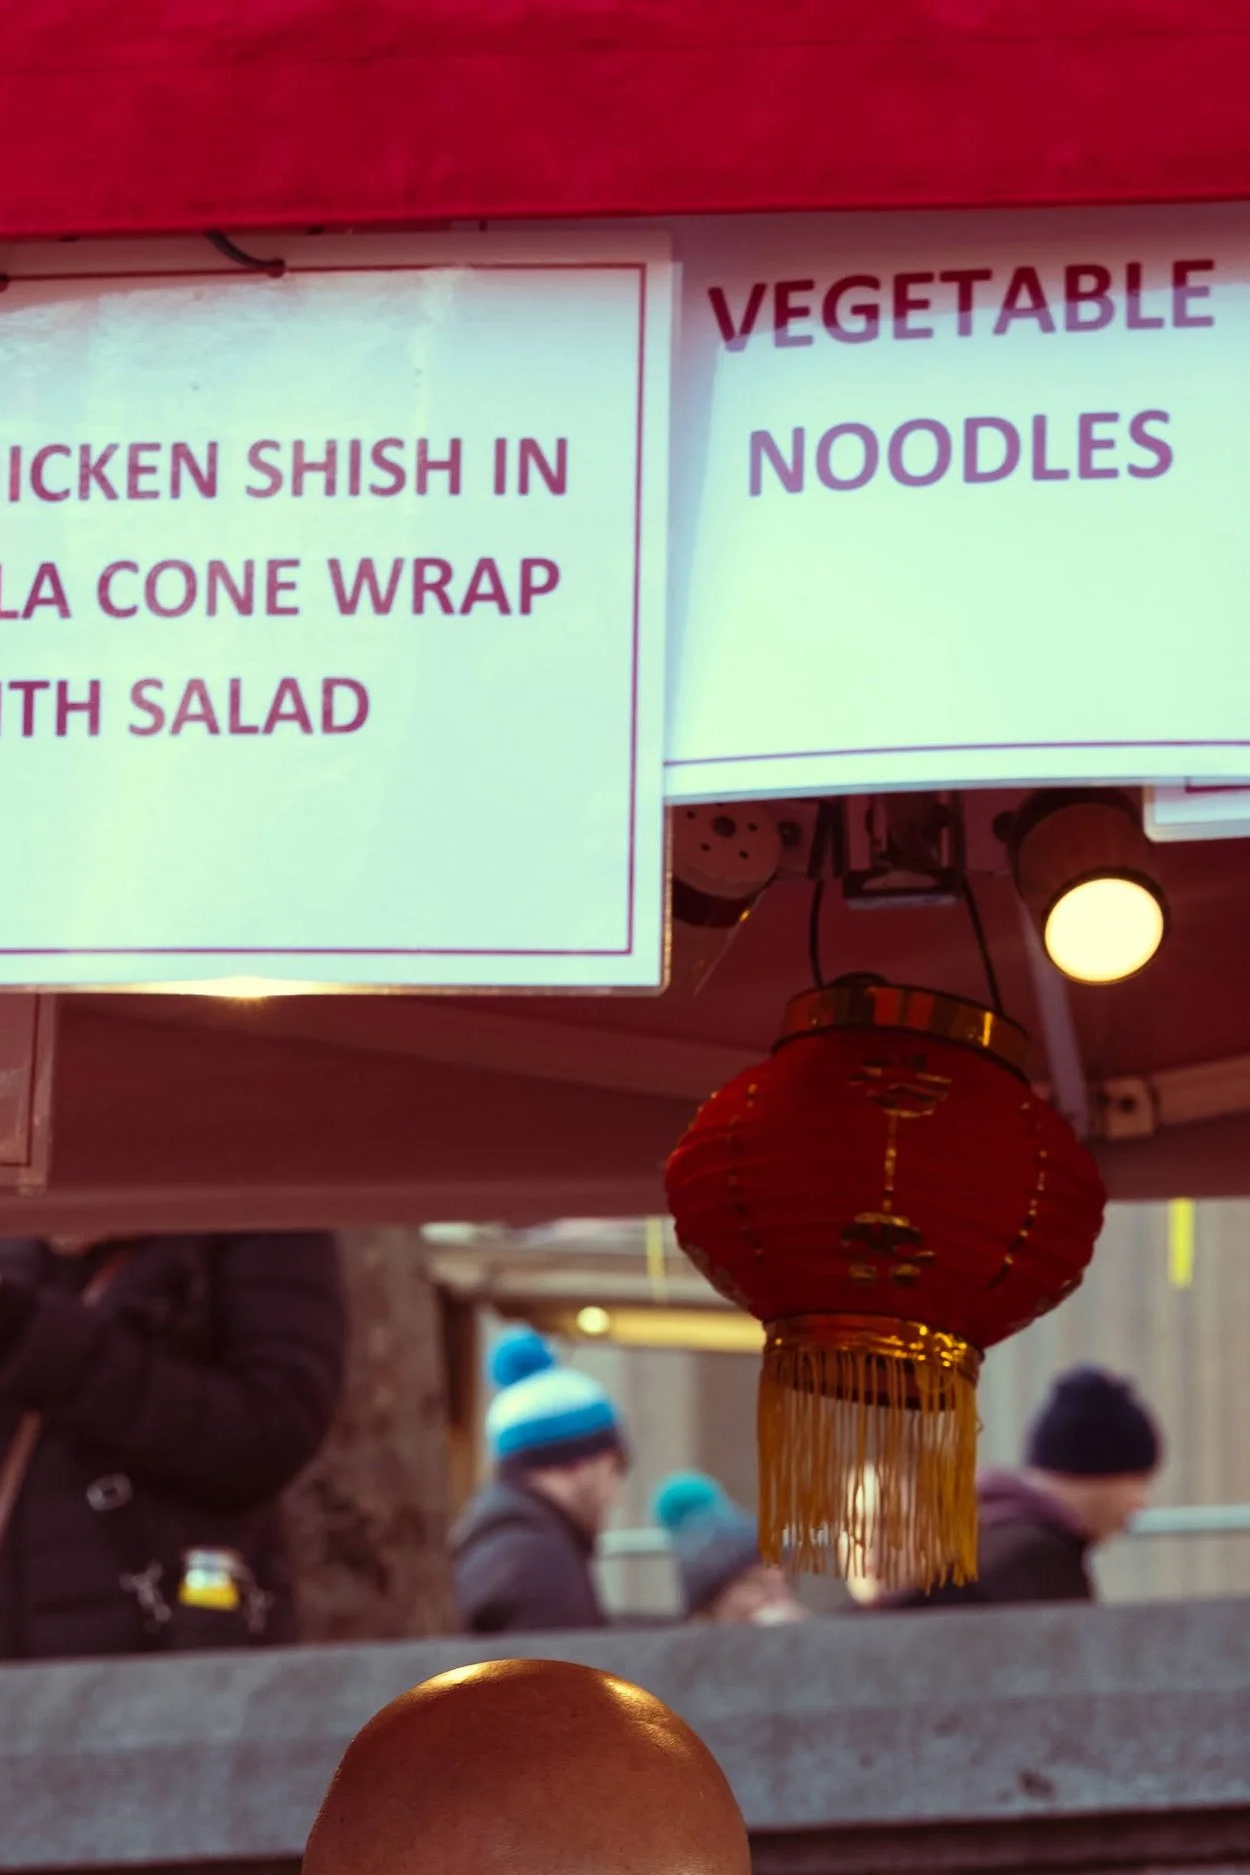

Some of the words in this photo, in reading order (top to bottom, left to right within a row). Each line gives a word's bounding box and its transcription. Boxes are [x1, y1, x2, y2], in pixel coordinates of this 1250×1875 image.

[707, 258, 1216, 353] VEGETABLE
[245, 436, 465, 500] SHISH
[492, 437, 571, 497] IN
[748, 409, 1174, 497] NOODLES
[96, 558, 301, 621] CONE
[326, 556, 561, 617] WRAP
[127, 676, 372, 737] SALAD
